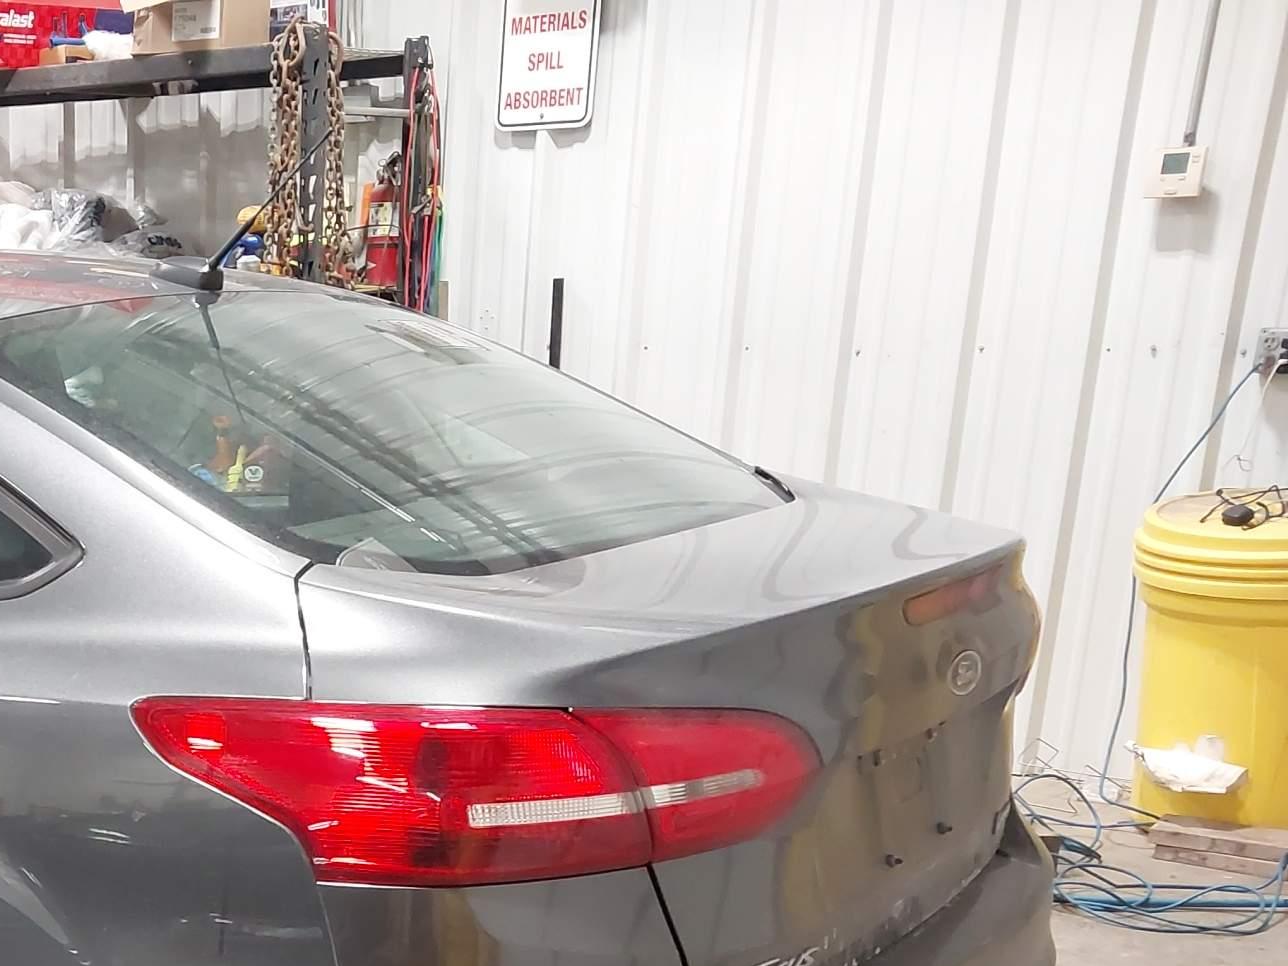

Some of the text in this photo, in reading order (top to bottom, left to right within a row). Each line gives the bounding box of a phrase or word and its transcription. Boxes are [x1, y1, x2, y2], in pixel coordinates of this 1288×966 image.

[511, 10, 587, 36] MATERIALS
[527, 51, 564, 72] SPILL
[504, 87, 583, 110] ABSORBENT
